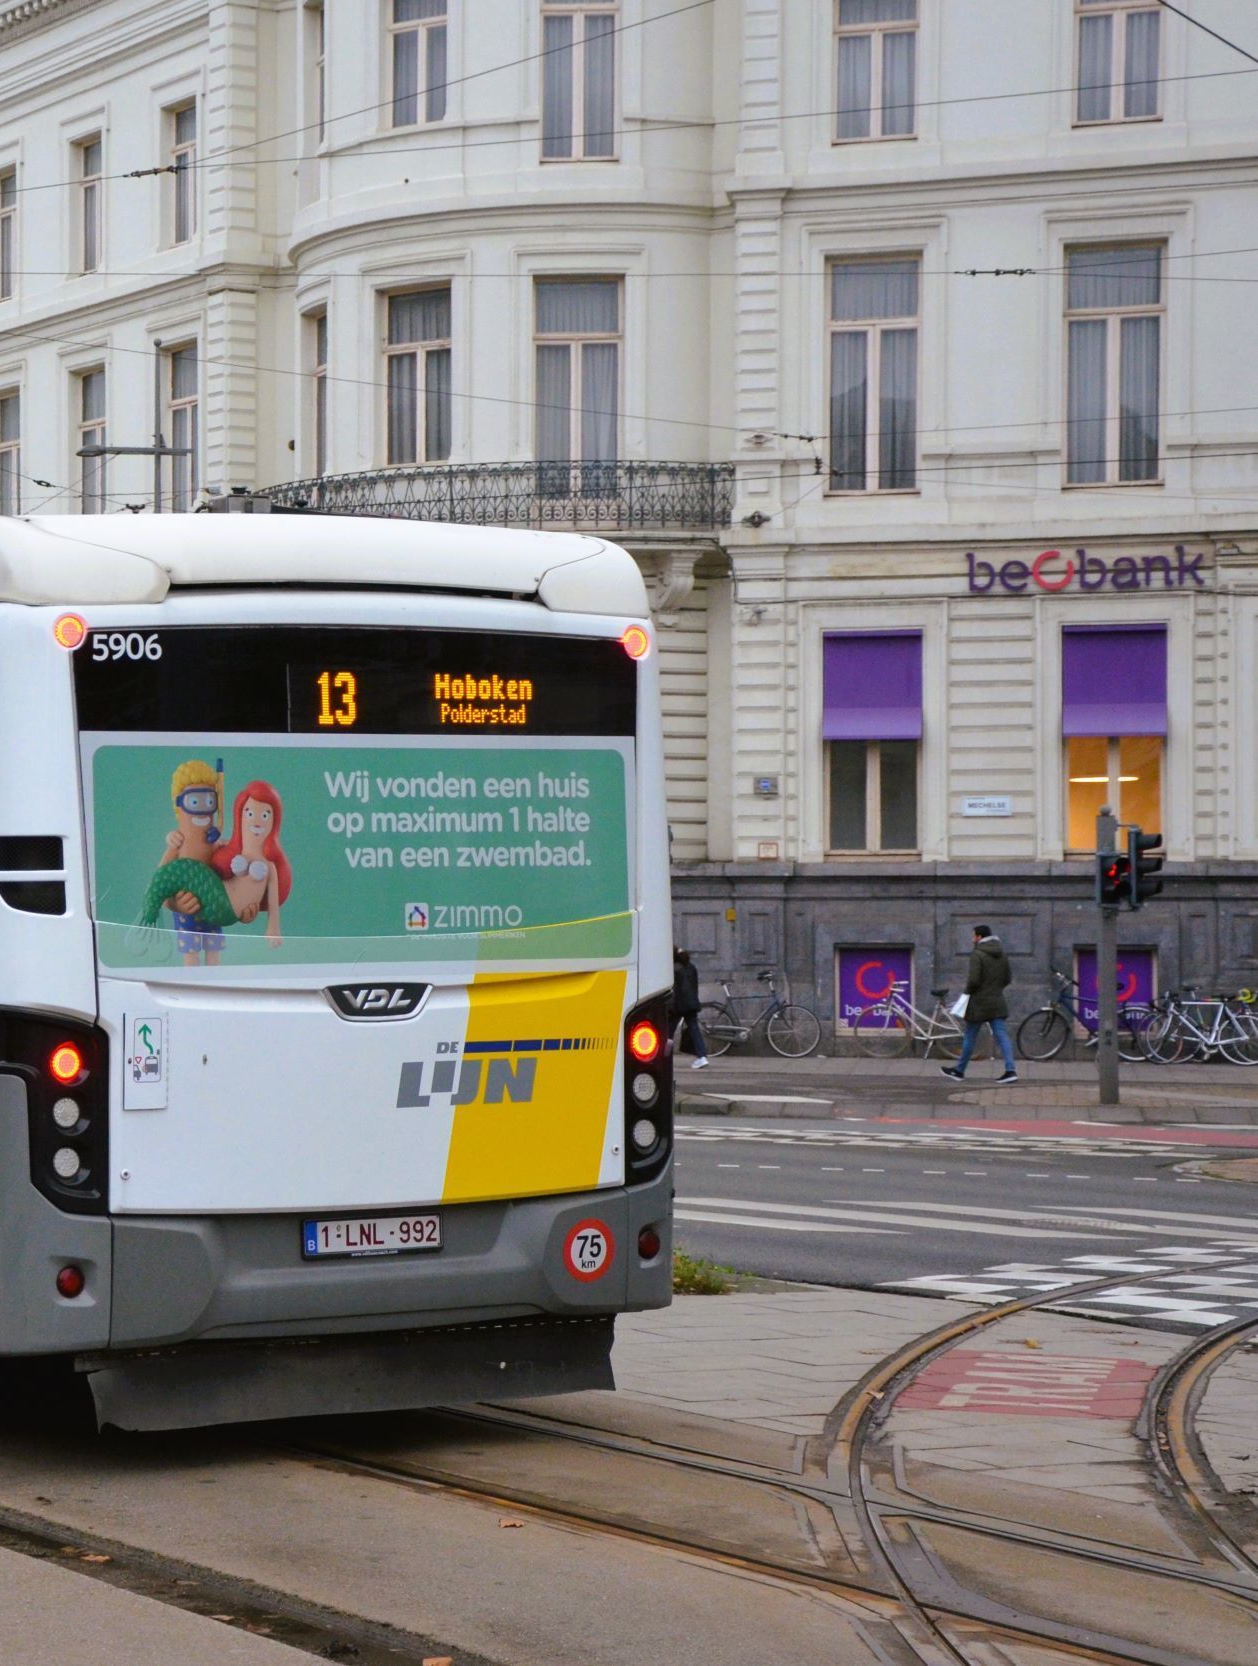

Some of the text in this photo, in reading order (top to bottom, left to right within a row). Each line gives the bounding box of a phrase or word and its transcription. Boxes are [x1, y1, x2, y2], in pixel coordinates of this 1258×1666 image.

[92, 633, 162, 661] 5906
[317, 672, 532, 725] 13 Hoboken
[441, 703, 526, 724] Polderstad
[324, 771, 590, 803] Wij vonden een huis
[327, 805, 591, 838] op maximum 1 halte
[345, 840, 592, 868] van een zwembad.
[343, 988, 412, 1010] VDL
[436, 1041, 459, 1054] DE
[396, 1057, 538, 1109] LIJN
[308, 1240, 316, 1251] B
[576, 1234, 602, 1259] 75
[581, 1259, 596, 1269] km
[938, 1352, 1118, 1410] TRAM
